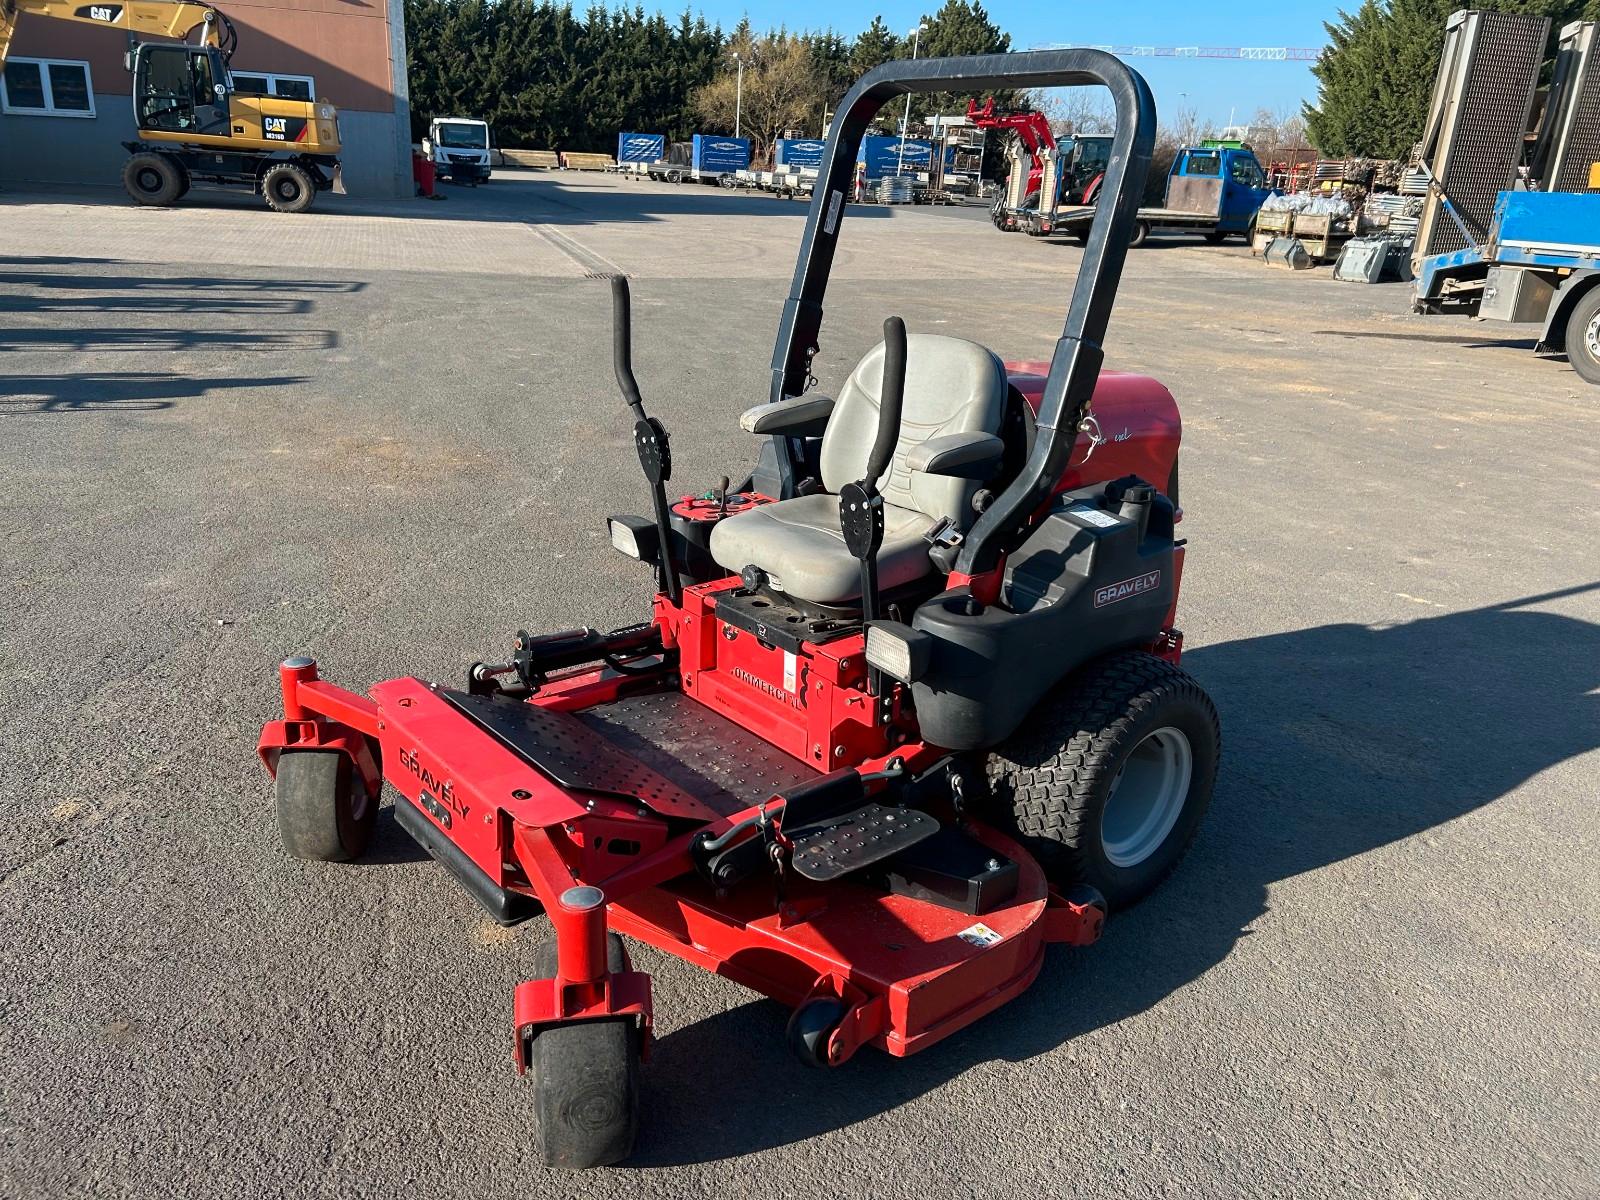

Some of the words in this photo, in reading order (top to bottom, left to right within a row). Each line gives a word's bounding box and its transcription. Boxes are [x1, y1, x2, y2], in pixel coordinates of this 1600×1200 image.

[90, 6, 112, 21] CAT
[265, 117, 287, 132] CAT
[1097, 572, 1158, 604] GRAVELY
[731, 667, 802, 712] OMMERCIL
[400, 746, 471, 820] GRAVELY
